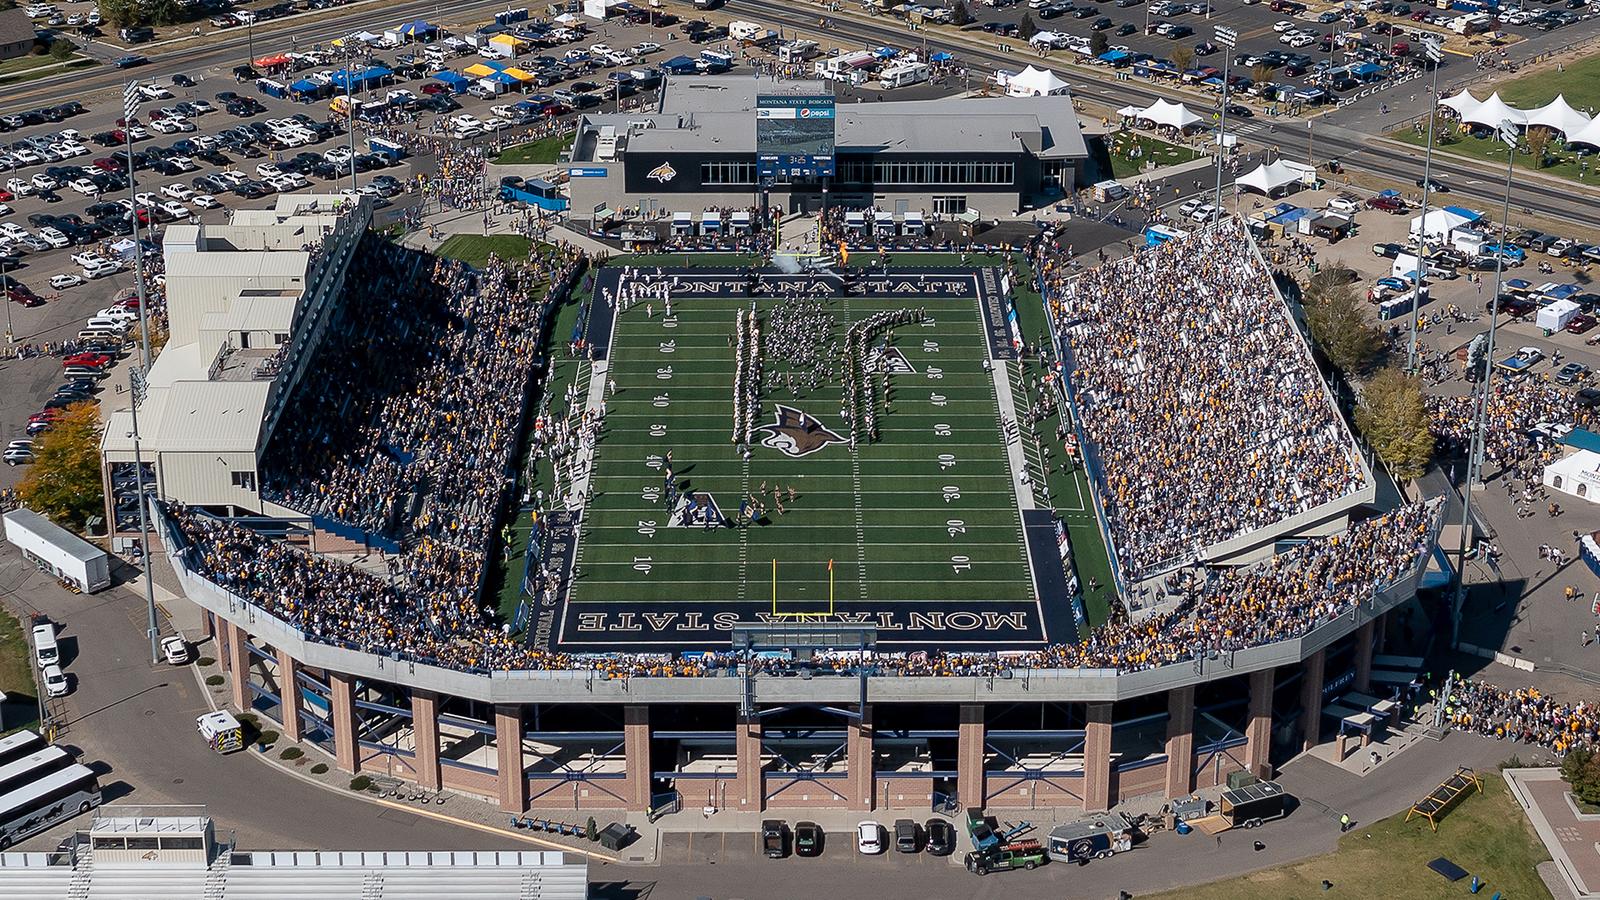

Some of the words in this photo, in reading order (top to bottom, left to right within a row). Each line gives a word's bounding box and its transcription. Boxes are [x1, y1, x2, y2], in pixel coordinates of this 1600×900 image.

[630, 281, 835, 293] MONTANA
[660, 342, 676, 352] 20
[923, 342, 939, 352] 20
[656, 368, 673, 379] 30
[926, 367, 943, 379] 30
[653, 395, 670, 407] 40
[930, 395, 947, 406] 40
[649, 424, 667, 436] 50
[934, 424, 952, 436] 50
[646, 455, 663, 467] 40
[938, 454, 956, 467] 40
[641, 486, 660, 500] 30
[942, 486, 960, 499] 30
[637, 520, 657, 534] 20
[946, 520, 966, 533] 20
[633, 556, 652, 571] 10
[951, 555, 971, 569] 10
[577, 612, 740, 632] STATE
[755, 612, 1027, 631] MONTANA
[533, 609, 555, 652] ATIONAL
